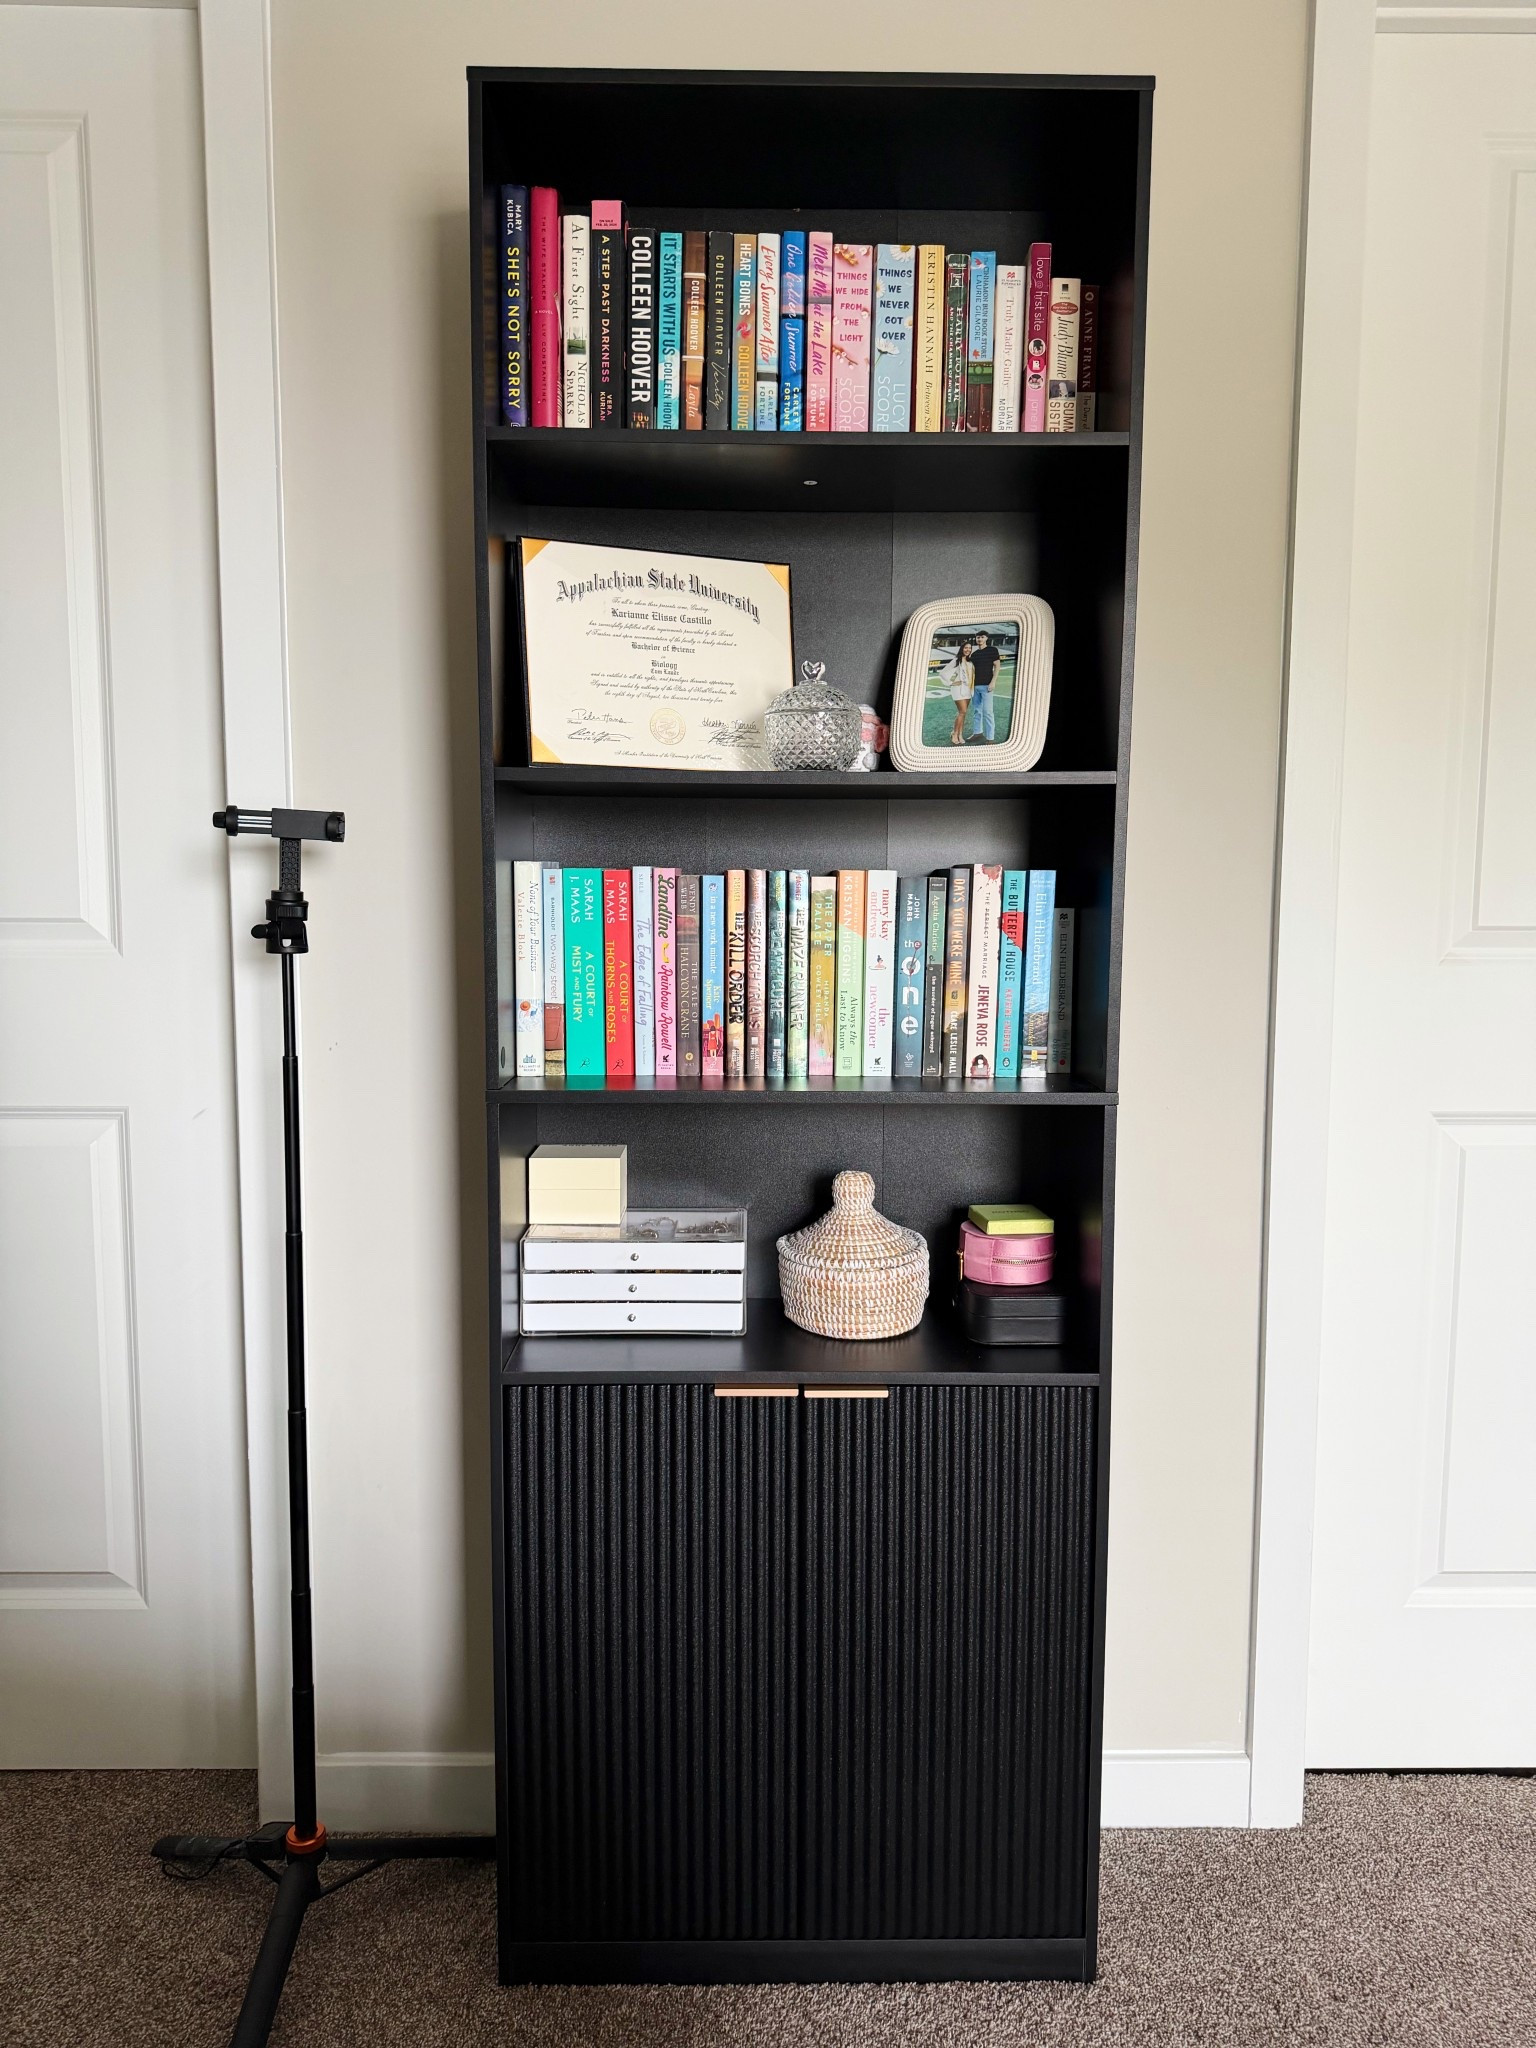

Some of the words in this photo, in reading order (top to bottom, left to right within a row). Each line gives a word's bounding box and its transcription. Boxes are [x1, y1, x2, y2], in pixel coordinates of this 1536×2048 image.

[664, 238, 677, 249] IT
[508, 247, 520, 297] SHE'S
[602, 249, 610, 278] STEP
[663, 254, 677, 298] STARTS
[740, 244, 752, 278] HEART
[878, 269, 912, 278] THINGS
[1036, 257, 1051, 279] love
[632, 236, 652, 320] COLLEEN
[715, 255, 724, 304] COLLEEN
[888, 285, 902, 293] WE
[602, 284, 610, 313] PAST
[739, 280, 751, 316] BONES
[880, 301, 910, 309] NEVER
[1004, 298, 1015, 323] Truly
[1034, 291, 1049, 310] first
[508, 306, 520, 342] NOT
[662, 303, 676, 339] WITH
[715, 313, 724, 355] HOOVER
[882, 332, 906, 340] OVER
[885, 317, 903, 325] GOT
[955, 307, 963, 350] HARRY
[1034, 313, 1045, 331] site
[1084, 309, 1093, 343] ANNE
[602, 319, 610, 383] DARKNESS
[662, 342, 676, 356] US
[840, 334, 863, 342] LIGHT
[1003, 326, 1014, 356] Madly
[508, 351, 520, 408] SORRY
[631, 328, 651, 402] HOOVER
[1002, 359, 1012, 387] Guilty
[1082, 347, 1092, 388] FRANK
[853, 385, 865, 429] LUCY
[892, 384, 906, 428] LUCY
[556, 570, 645, 604] Appalachian
[647, 568, 686, 592] State
[689, 573, 760, 625] University
[611, 607, 649, 620] Karianne
[652, 611, 678, 622] Elisse
[680, 614, 712, 625] Castillo
[631, 642, 661, 651] Bachelor
[671, 644, 696, 654] Science
[651, 660, 678, 669] Biology
[584, 879, 594, 920] SARAH
[619, 882, 628, 921] SARAH
[658, 874, 675, 939] Landline
[825, 895, 833, 917] THE
[844, 876, 853, 926] KRISTAN
[880, 889, 890, 918] mary
[953, 879, 966, 903] DAYS
[796, 908, 805, 926] THE
[869, 891, 881, 938] andrews
[931, 895, 940, 921] Agatha
[952, 907, 965, 927] YOU
[1006, 894, 1018, 946] BUTTERFLY
[814, 903, 822, 945] PALACE
[824, 922, 832, 956] PAPER
[879, 920, 893, 940] kay
[932, 922, 940, 952] Christie
[790, 926, 806, 970] MAZE
[842, 932, 852, 984] HIGGINS
[950, 930, 964, 957] WERE
[1059, 933, 1067, 954] ELIN
[571, 945, 582, 974] MIST
[606, 941, 616, 988] THORNS
[681, 947, 690, 998] HALCYON
[950, 960, 962, 985] MINE
[1005, 951, 1016, 982] HOUSE
[790, 971, 805, 1031] RUNNER
[977, 985, 989, 1020] JENEVA
[1058, 956, 1067, 1021] HILDERBRAND
[572, 992, 583, 1023] FURY
[680, 1000, 690, 1038] CRANE
[692, 1012, 698, 1023] OF
[868, 985, 877, 1049] newcomer
[879, 1008, 890, 1027] the
[931, 1008, 936, 1016] of
[607, 1005, 616, 1043] ROSES
[976, 1023, 988, 1047] ROSE
